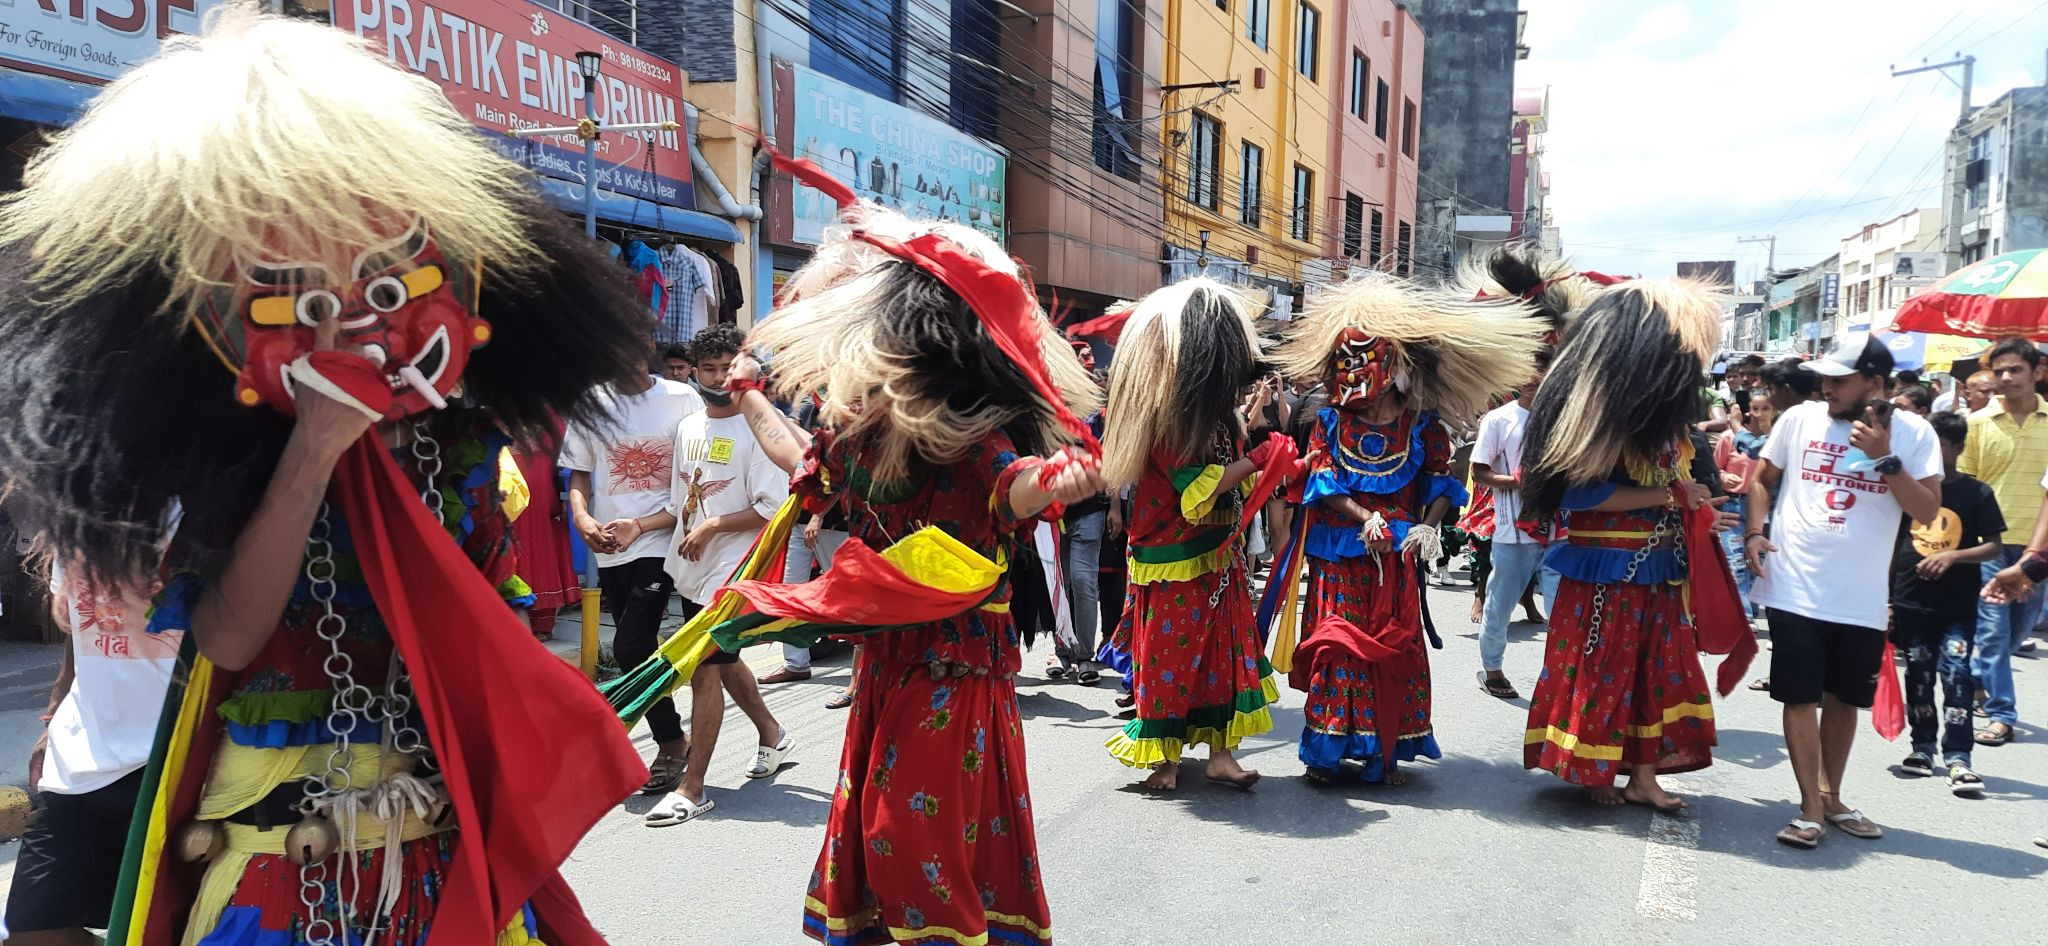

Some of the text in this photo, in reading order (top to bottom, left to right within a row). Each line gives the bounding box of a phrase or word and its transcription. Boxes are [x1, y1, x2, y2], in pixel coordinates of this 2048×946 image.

[0, 22, 119, 67] For Foreign Goods.
[353, 0, 681, 152] PRATIK EMPORIUM
[602, 44, 672, 84] Ph: 9818932334
[475, 103, 506, 126] Main
[809, 89, 997, 178] THE CHINA SHOP
[577, 160, 611, 184] Gnts
[614, 169, 623, 187] &
[625, 172, 648, 193] Kids
[926, 159, 951, 179] Morang
[1809, 440, 1848, 453] KEEP
[1801, 472, 1889, 494] BUTTONED
